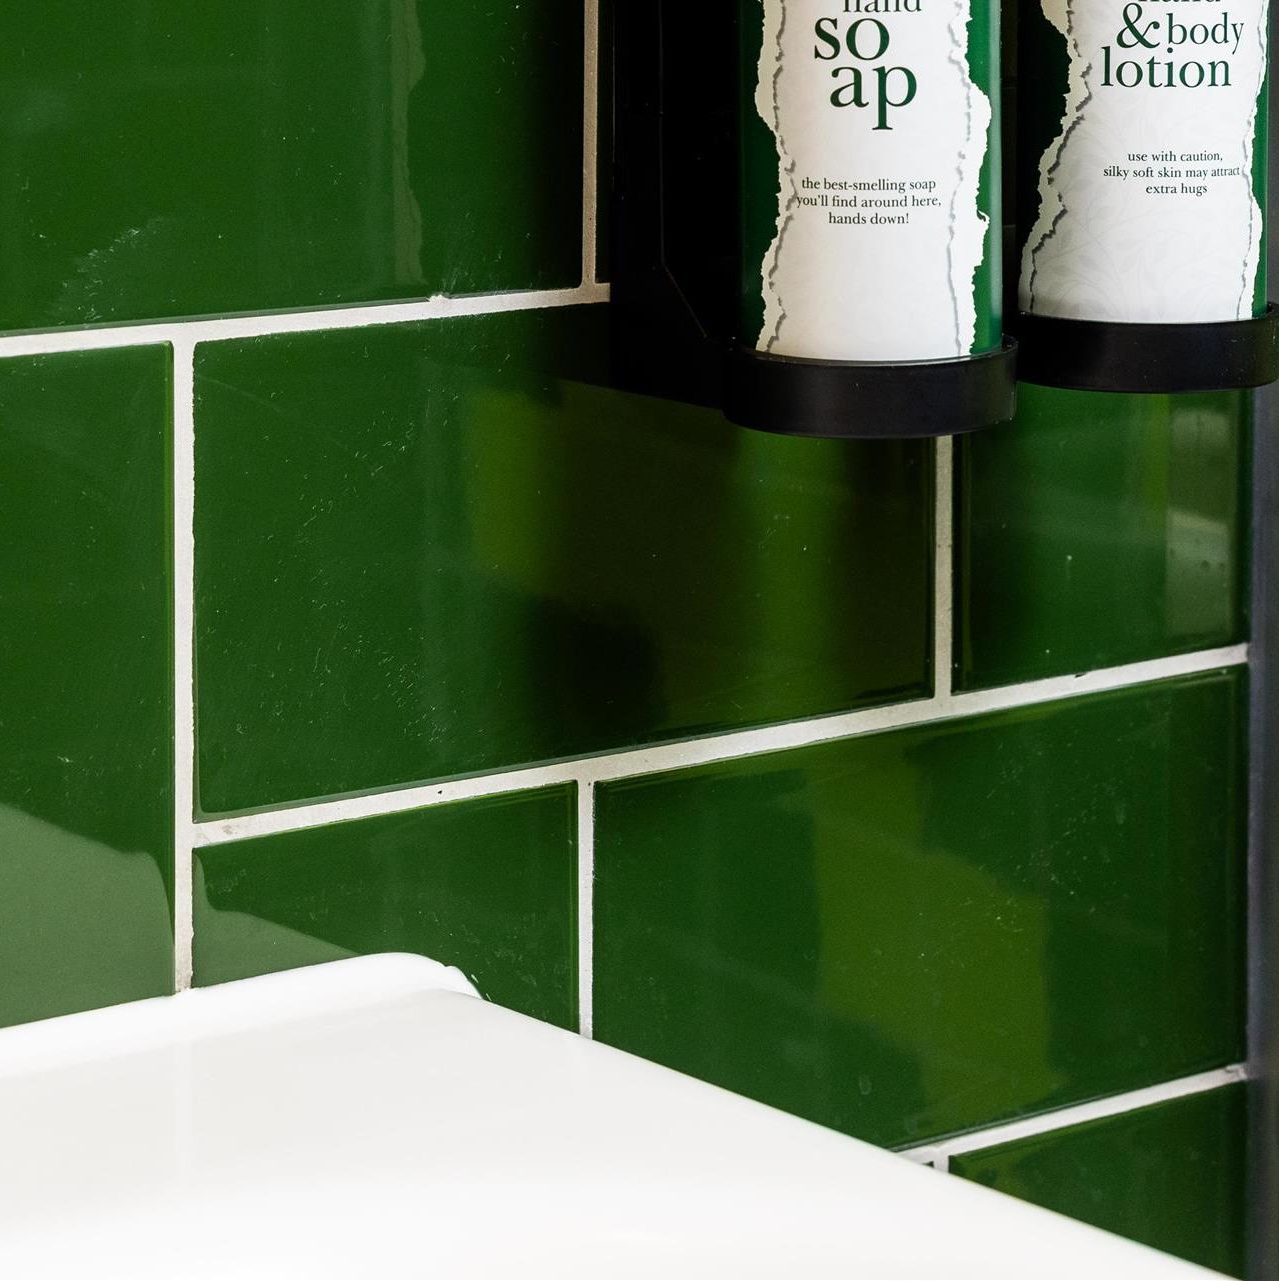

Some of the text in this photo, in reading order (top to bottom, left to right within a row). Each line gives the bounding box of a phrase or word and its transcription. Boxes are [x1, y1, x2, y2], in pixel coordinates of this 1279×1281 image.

[813, 17, 890, 61] so
[1100, 46, 1232, 89] lotion
[829, 65, 917, 131] ap
[1127, 150, 1223, 163] use with caution,
[1103, 165, 1240, 181] silky soft skin may attract
[801, 176, 936, 194] the best-smelling soap
[1145, 182, 1209, 197] extra hugs
[796, 194, 942, 209] you'll find around here,
[828, 211, 910, 225] hands down!
